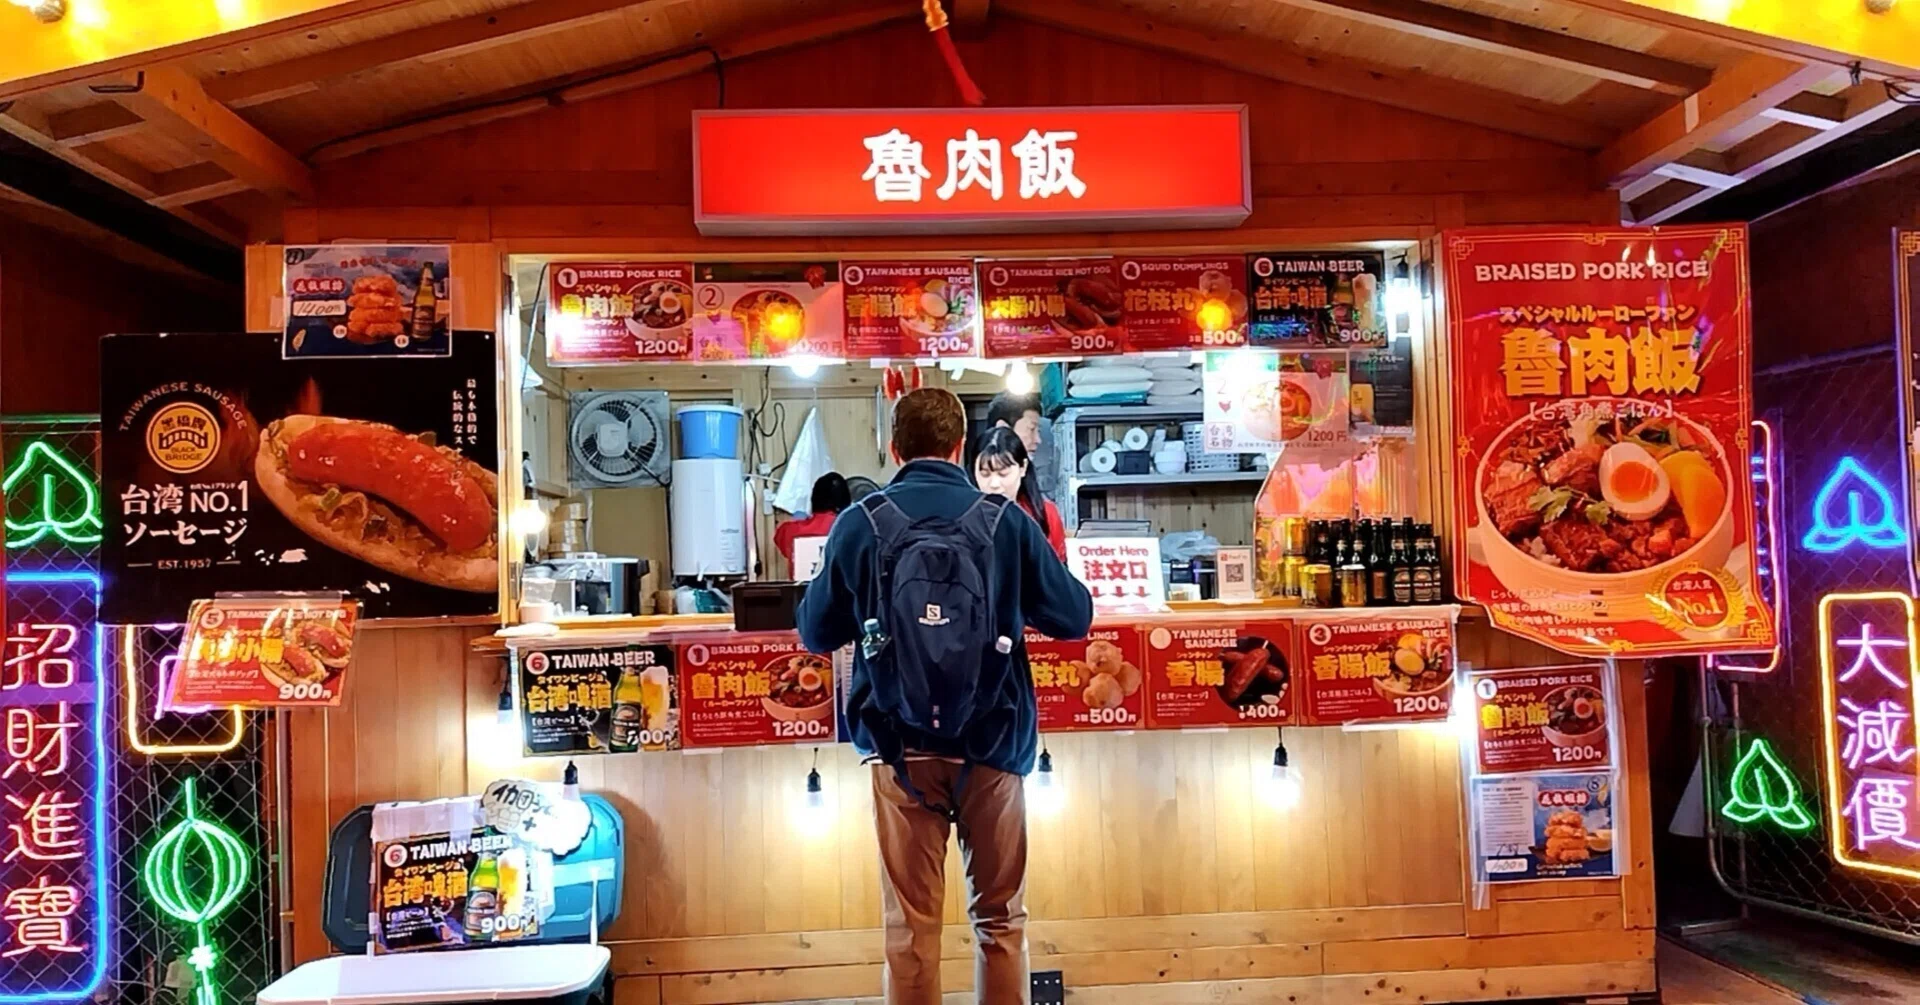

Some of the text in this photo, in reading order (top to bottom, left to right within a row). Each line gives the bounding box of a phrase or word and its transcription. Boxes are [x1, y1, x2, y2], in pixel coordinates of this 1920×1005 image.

[861, 128, 1087, 202] 魯肉飯
[865, 266, 970, 276] TAIWANESE SAUSAGE
[1010, 265, 1111, 277] TAIWANESE RICE HOT DOG
[1142, 262, 1229, 272] SQUID DUMPLINGS
[1276, 260, 1365, 273] TAIWAN BEER
[1475, 260, 1709, 282] BRAISED PORK RICE
[579, 269, 682, 279] BRAISED PORK RICE
[948, 276, 972, 285] RICE
[576, 283, 621, 293] スペシャル
[1124, 288, 1194, 311] 花枝丸
[1499, 304, 1695, 324] スペシャルルーローファン
[1500, 326, 1701, 397] 魯肉飯
[119, 382, 247, 431] TAIWANESE SAUSAGE
[1307, 431, 1348, 442] 1200 円
[165, 453, 203, 461] BRIDGE
[171, 446, 196, 454] BLACK
[120, 480, 250, 516] 台湾 NO.1
[123, 517, 249, 548] ソーセージ
[1079, 546, 1149, 558] Order Here
[158, 559, 212, 570] EST.1957
[1084, 560, 1148, 580] 注文口
[1672, 579, 1713, 591] 台湾人気
[1675, 591, 1723, 620] No.1
[1332, 620, 1446, 634] TAIWANESE SAUSAGE
[1423, 629, 1448, 638] RICE
[1087, 631, 1119, 641] LINGS
[1172, 629, 1237, 640] TAIWANESE
[711, 644, 760, 655] BRAISED
[763, 643, 794, 652] PORK
[1185, 637, 1238, 649] SAUSAGE
[551, 651, 655, 670] TAIWAN BEER
[707, 660, 757, 671] スペシャル
[1313, 651, 1392, 681] 香腸飯
[1030, 660, 1081, 688] 枝丸
[1166, 660, 1225, 687] 香腸
[691, 670, 771, 699] 魯肉飯
[1497, 674, 1593, 689] BRAISED PORK RICE
[1495, 693, 1537, 703] スペシャル
[1481, 702, 1550, 730] 魯肉飯
[1836, 623, 1920, 853] 大減價
[2, 622, 88, 957] 招財進寶
[411, 834, 513, 860] TAIWAN BEER
